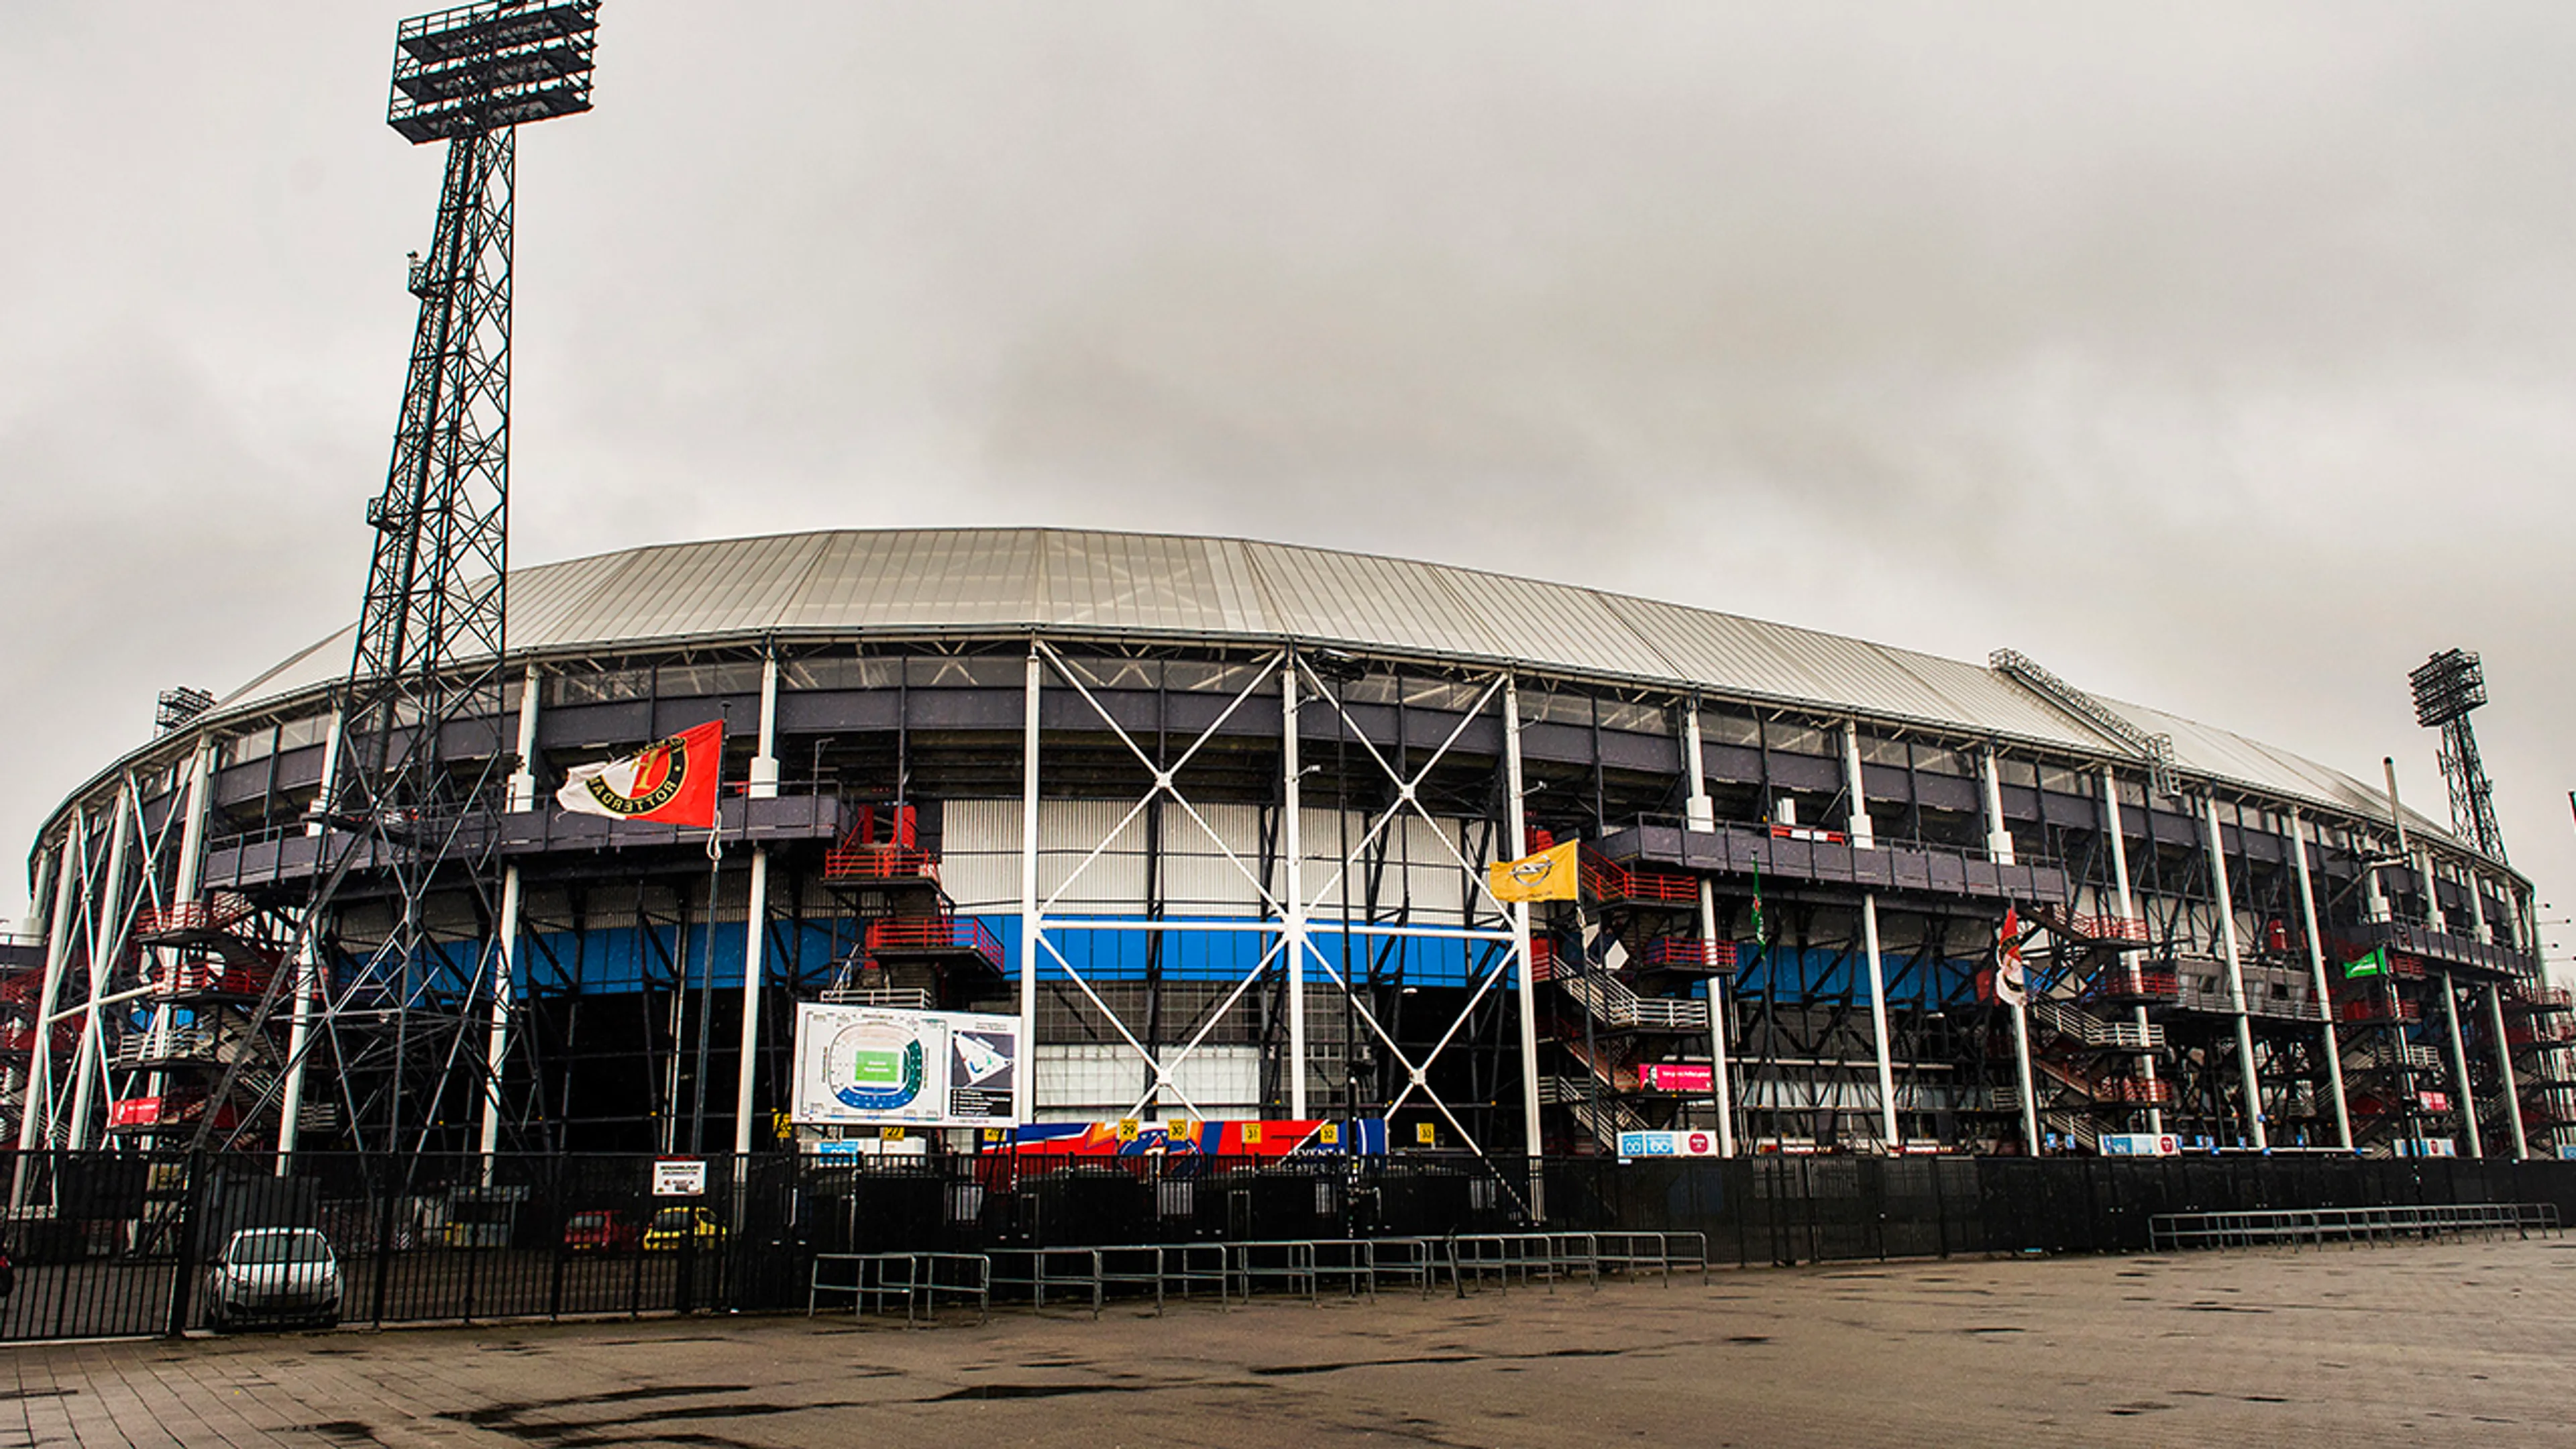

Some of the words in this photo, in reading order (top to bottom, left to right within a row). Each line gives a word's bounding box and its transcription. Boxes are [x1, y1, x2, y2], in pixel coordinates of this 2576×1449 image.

[1123, 1124, 1136, 1135] 29
[1172, 1124, 1184, 1136] 30
[1248, 1128, 1258, 1140] 31
